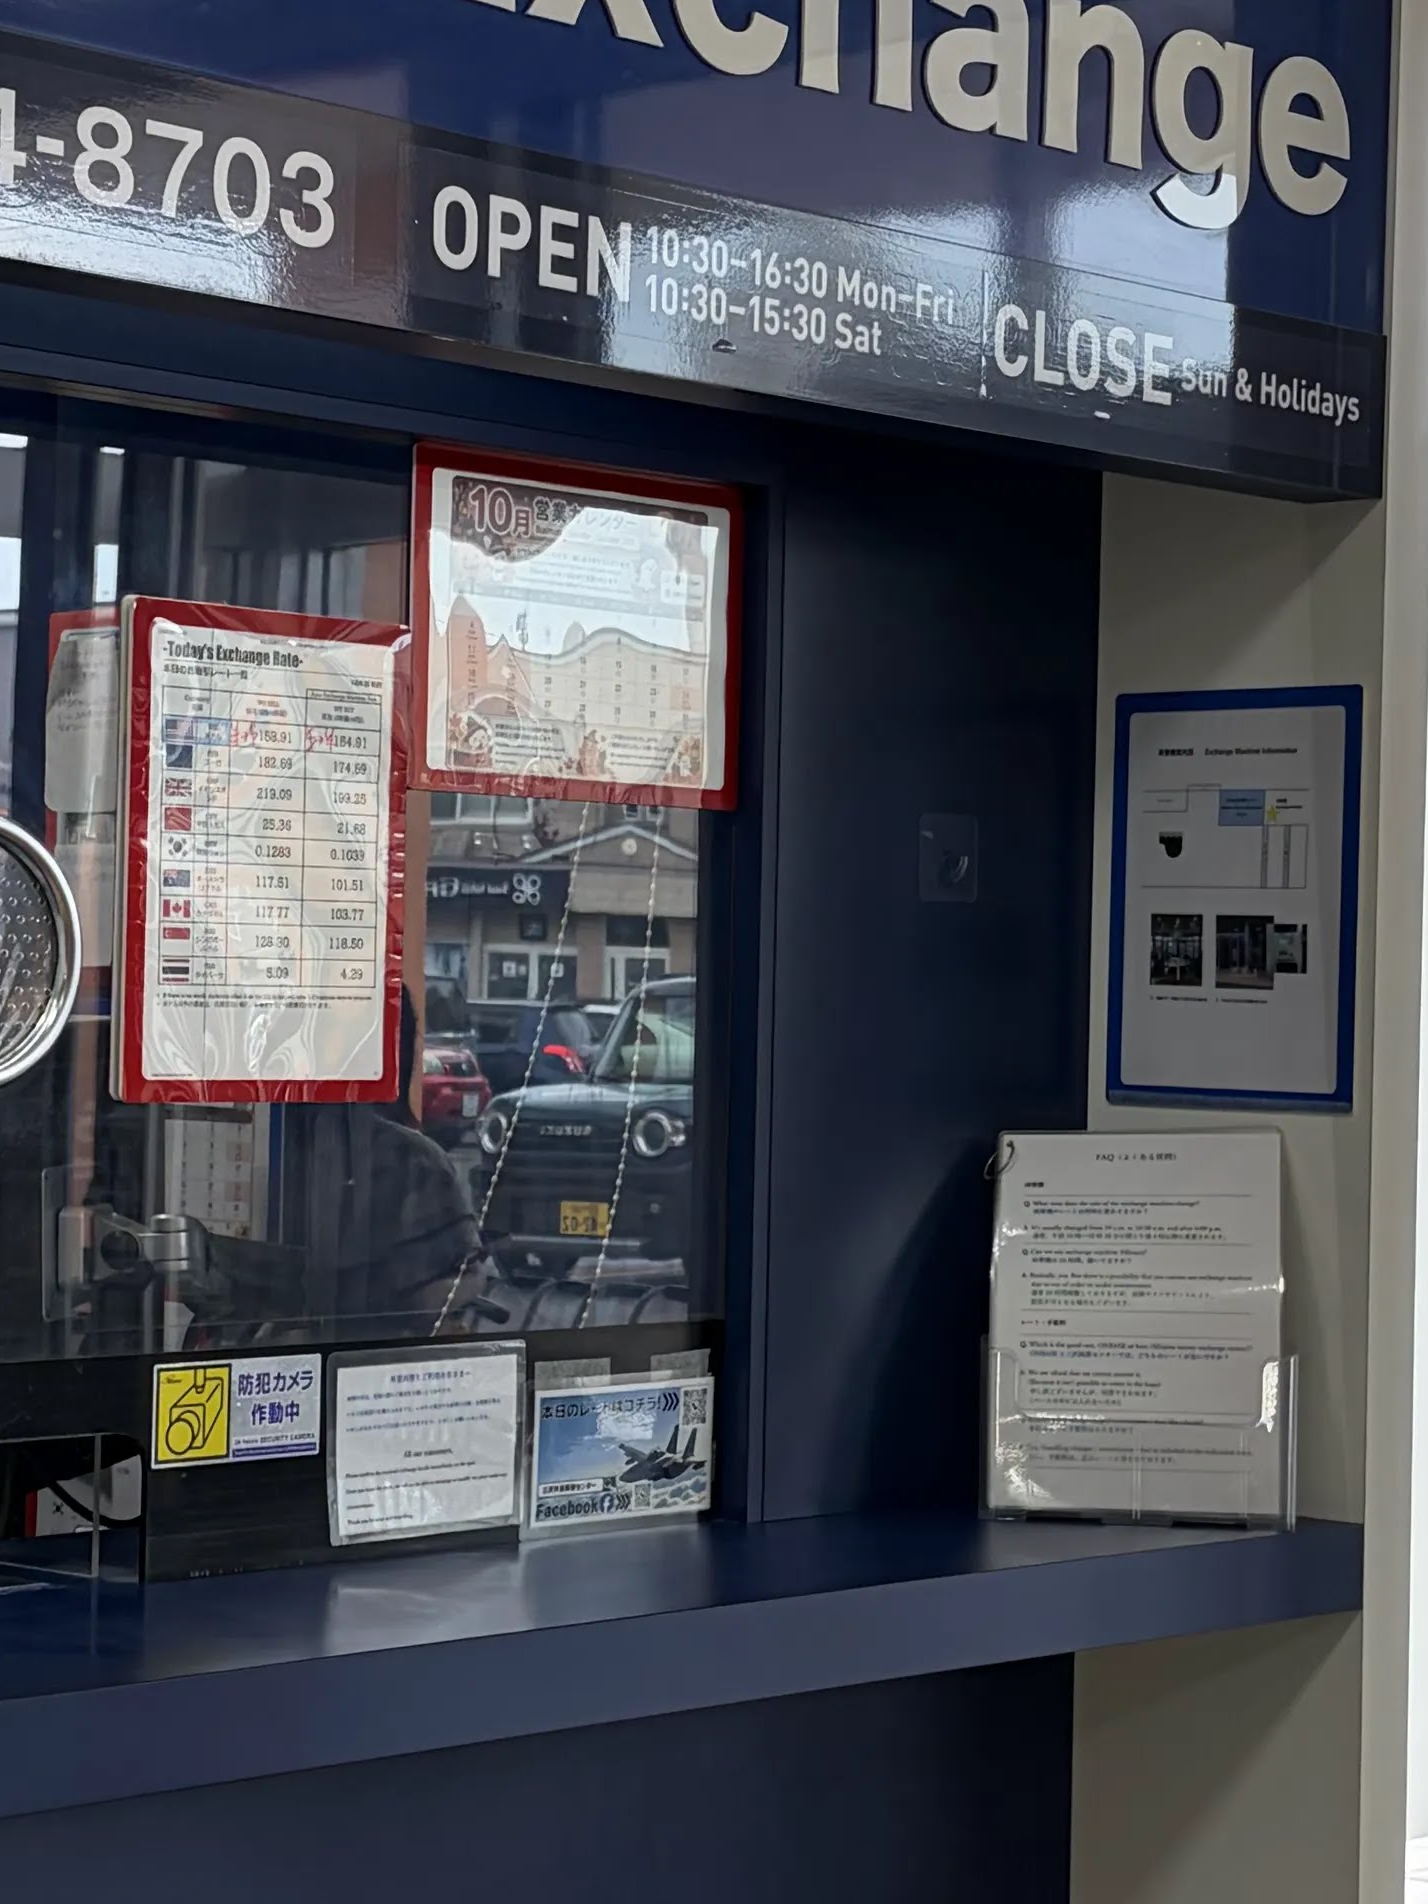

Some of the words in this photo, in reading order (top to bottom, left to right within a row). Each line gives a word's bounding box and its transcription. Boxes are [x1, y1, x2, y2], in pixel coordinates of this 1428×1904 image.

[433, 185, 631, 303] OPEN
[646, 228, 828, 298] 10:30-16:30
[836, 266, 954, 324] Mon-Fri
[645, 274, 827, 345] 10:30-15:30
[835, 312, 882, 355] Sat
[994, 304, 1172, 406] CLOSE
[1181, 358, 1227, 397] Sun
[1235, 368, 1253, 402] &
[1260, 372, 1360, 427] Holidays
[216, 645, 270, 666] Exchange
[331, 878, 364, 892] 101.51
[330, 908, 364, 921] 103.77
[329, 936, 364, 950] 118.50
[1096, 1153, 1114, 1162] FAQ
[238, 1370, 314, 1397] 防犯カメラ
[251, 1400, 300, 1426] 作動中
[536, 1500, 599, 1519] Facebook
